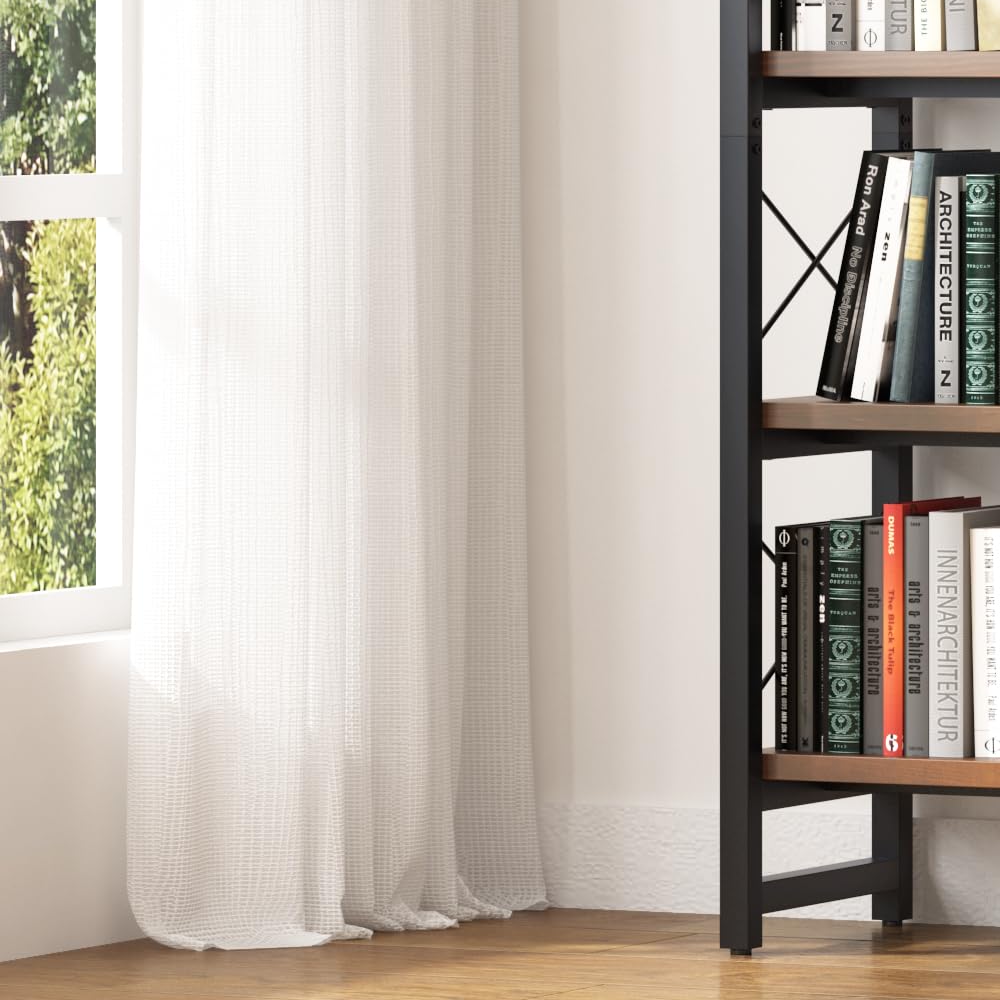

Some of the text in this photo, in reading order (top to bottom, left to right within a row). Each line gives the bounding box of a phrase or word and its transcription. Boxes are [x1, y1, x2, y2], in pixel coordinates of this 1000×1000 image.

[834, 164, 879, 344] Ron Arad No Discipline
[881, 231, 891, 262] zen
[939, 190, 952, 342] ARCHITECTURE
[867, 587, 882, 609] arts
[908, 581, 923, 604] arts
[867, 628, 883, 696] architecture
[887, 647, 895, 676] Tulip
[908, 623, 924, 695] architecture
[937, 550, 958, 742] INNENARCHITEKTUR
